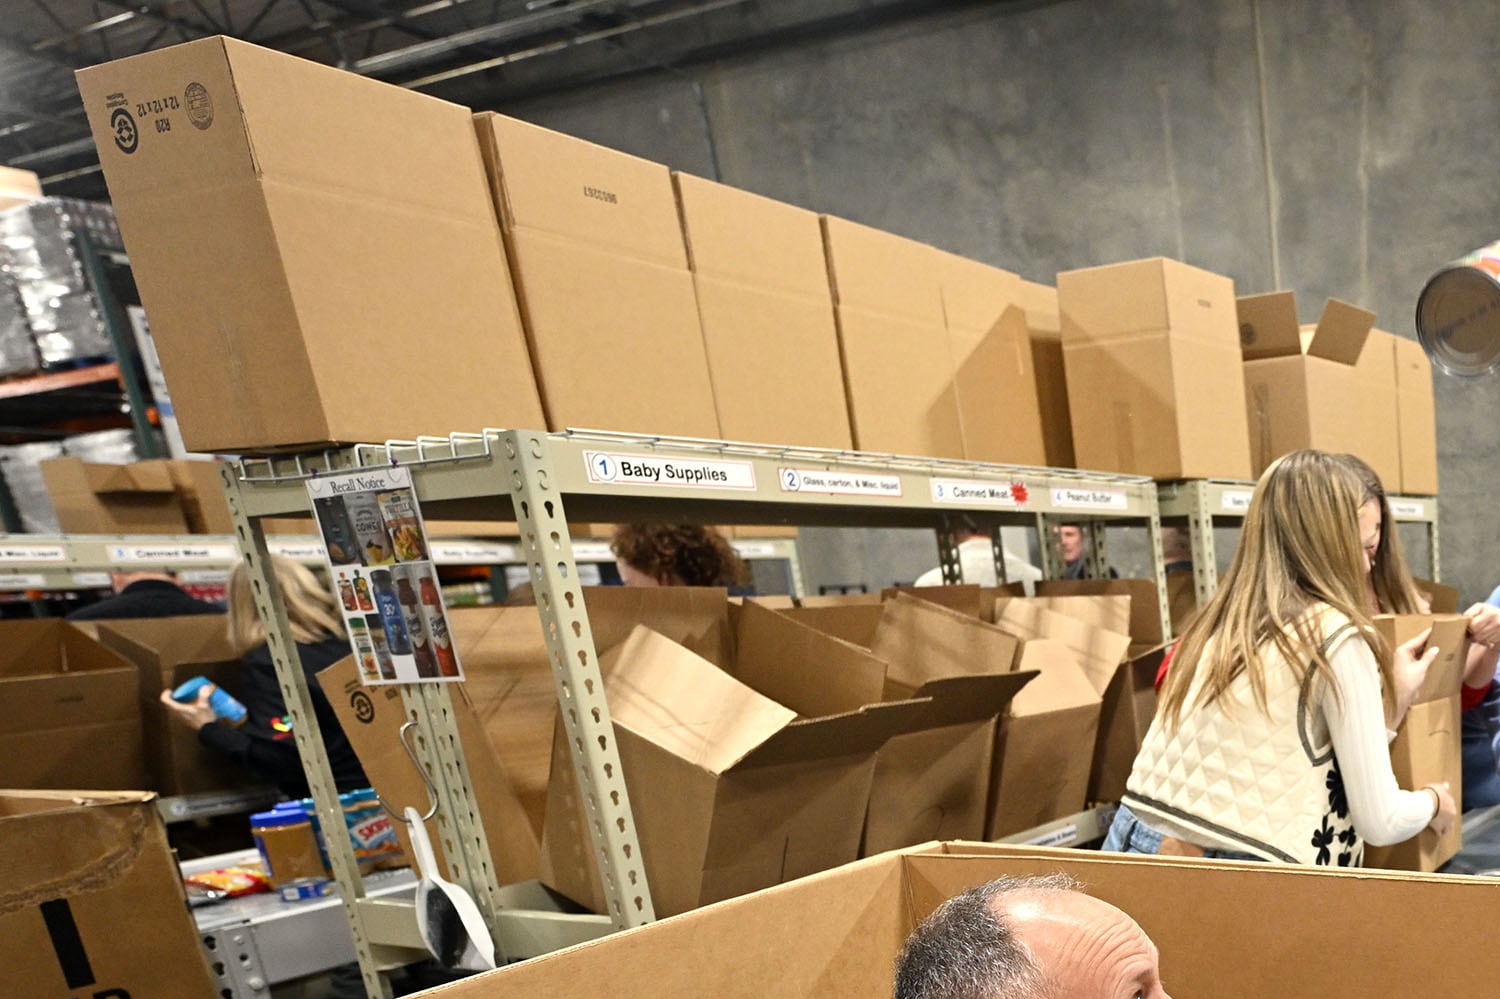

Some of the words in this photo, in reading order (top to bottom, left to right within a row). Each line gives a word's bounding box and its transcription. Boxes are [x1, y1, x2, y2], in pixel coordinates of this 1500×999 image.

[599, 459, 608, 475] 1
[621, 461, 661, 482] Baby
[664, 464, 728, 483] Supplies
[329, 478, 355, 494] Recall
[356, 476, 386, 490] Notice
[787, 472, 796, 487] 2
[937, 485, 944, 497] 3
[953, 486, 987, 498] Canned
[988, 488, 1009, 499] Meat
[1066, 491, 1091, 502] Peanut
[1092, 492, 1112, 503] Butter
